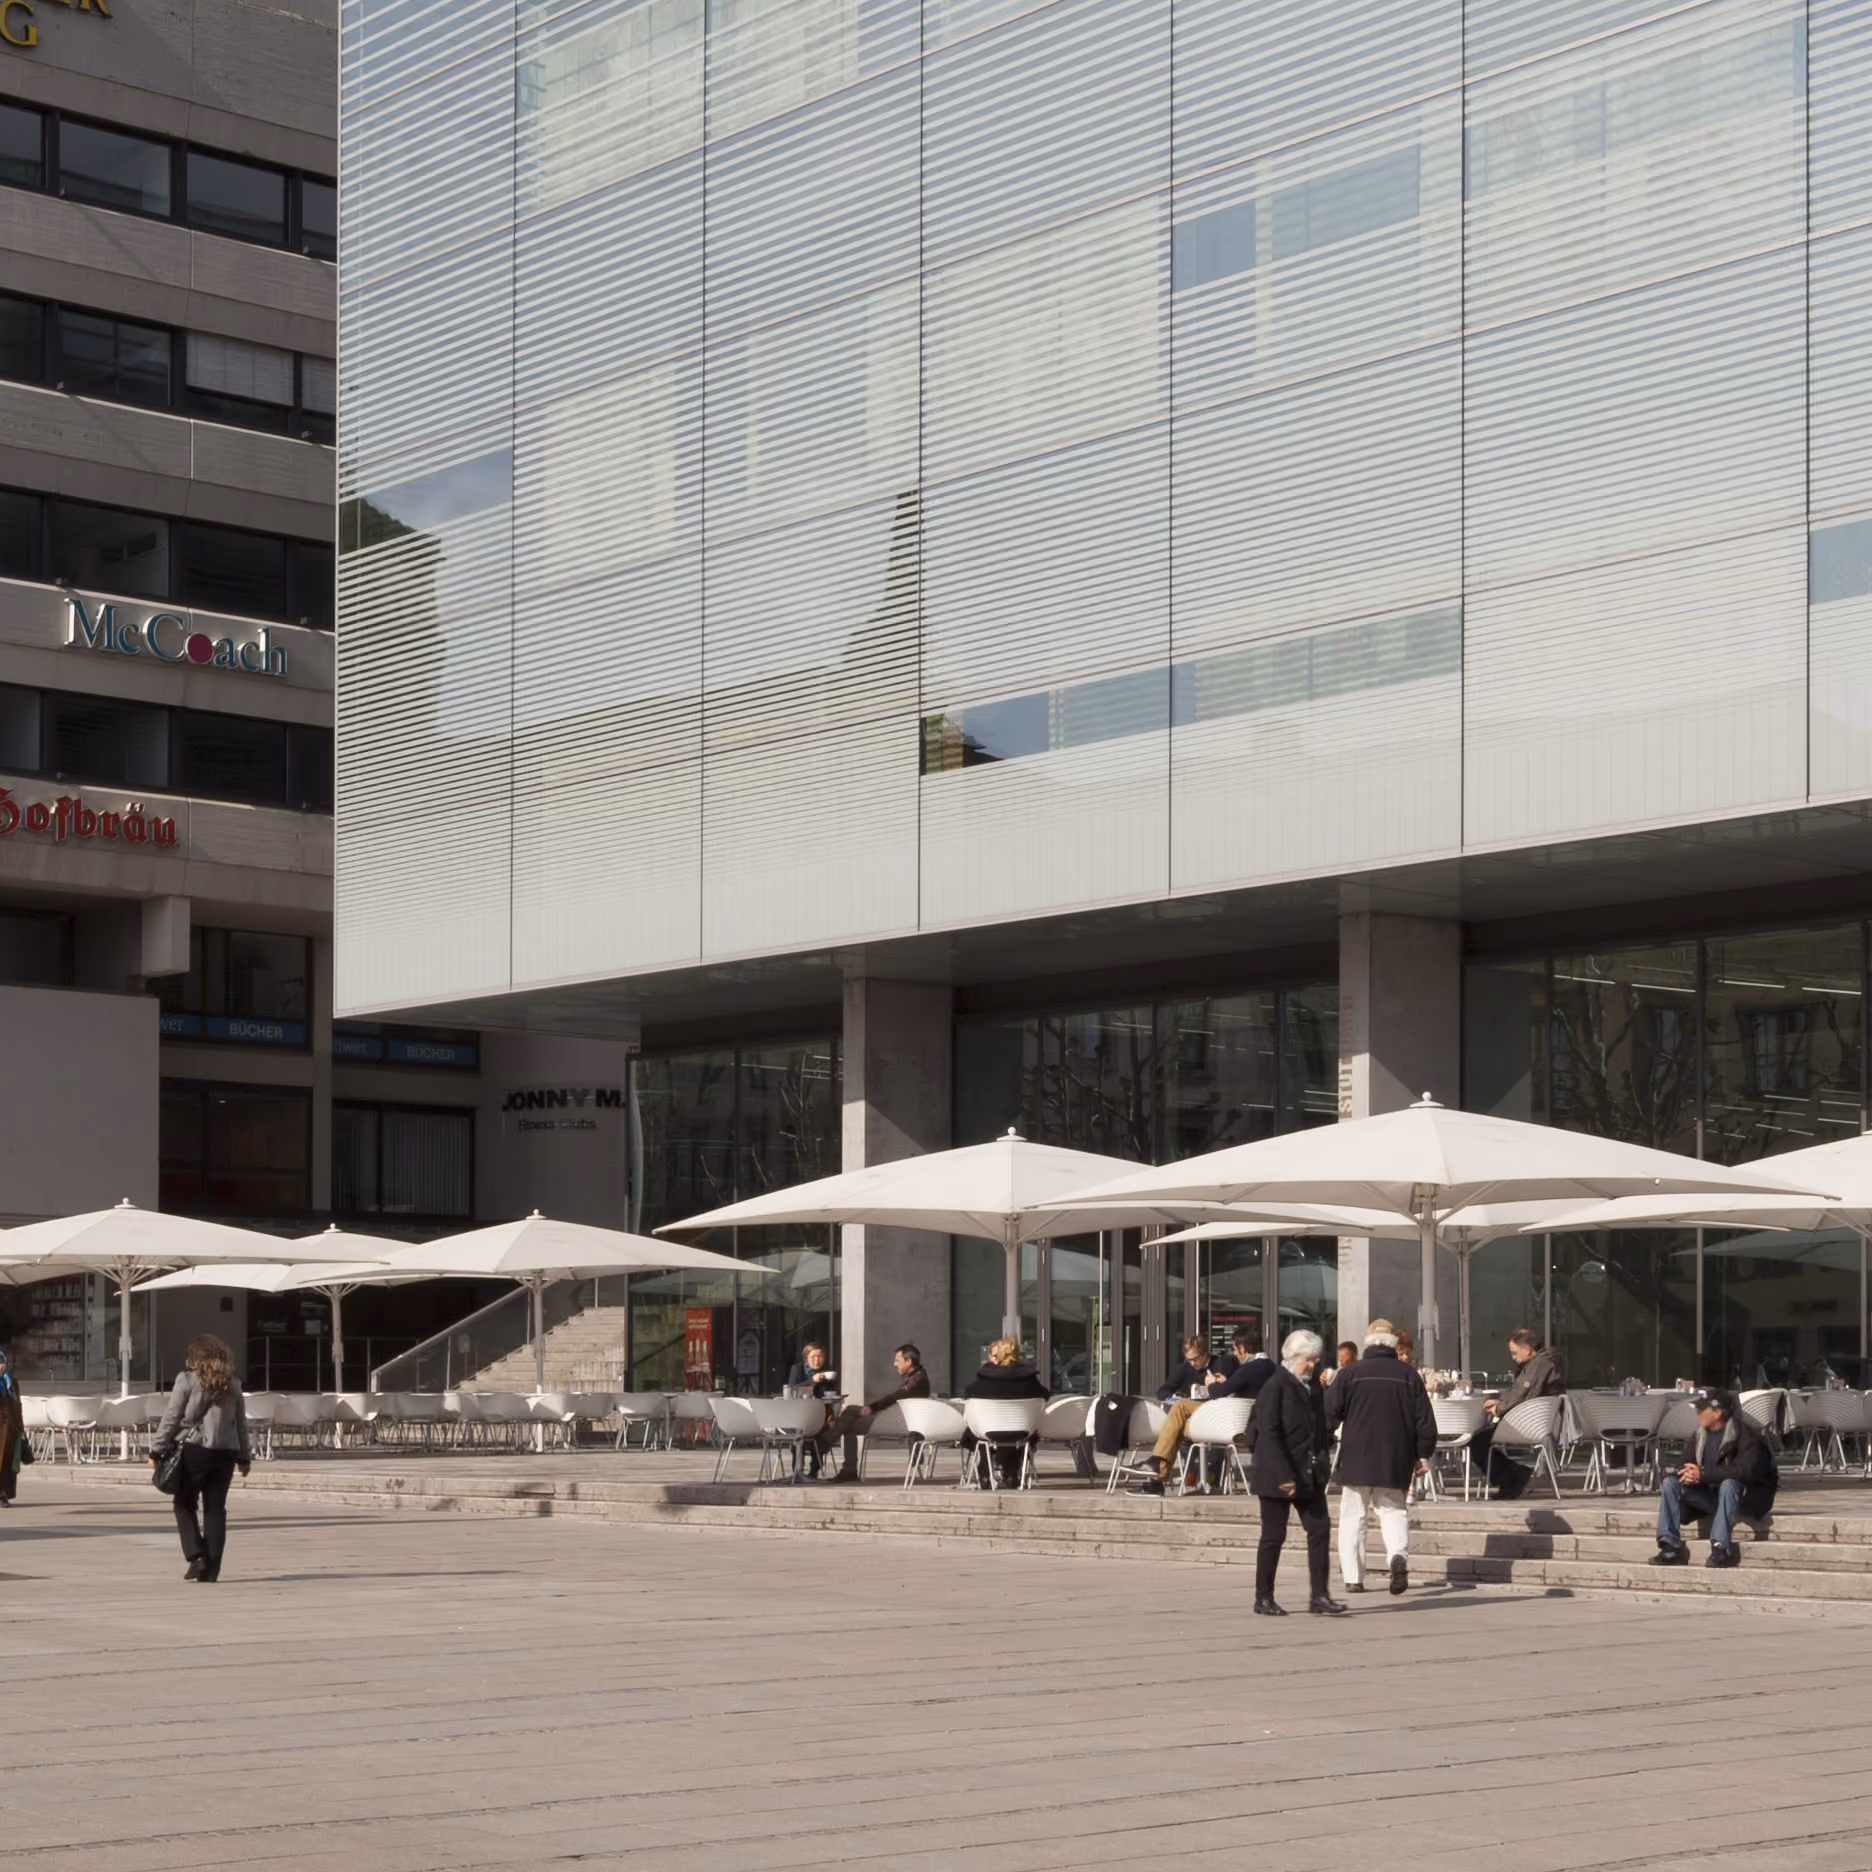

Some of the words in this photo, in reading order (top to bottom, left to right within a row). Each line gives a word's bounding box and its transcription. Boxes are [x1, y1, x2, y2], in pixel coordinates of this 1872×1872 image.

[228, 1020, 284, 1040] BÜCHER
[406, 1044, 456, 1062] BÜCHER
[501, 1088, 592, 1113] JONNY
[595, 1089, 626, 1110] M.
